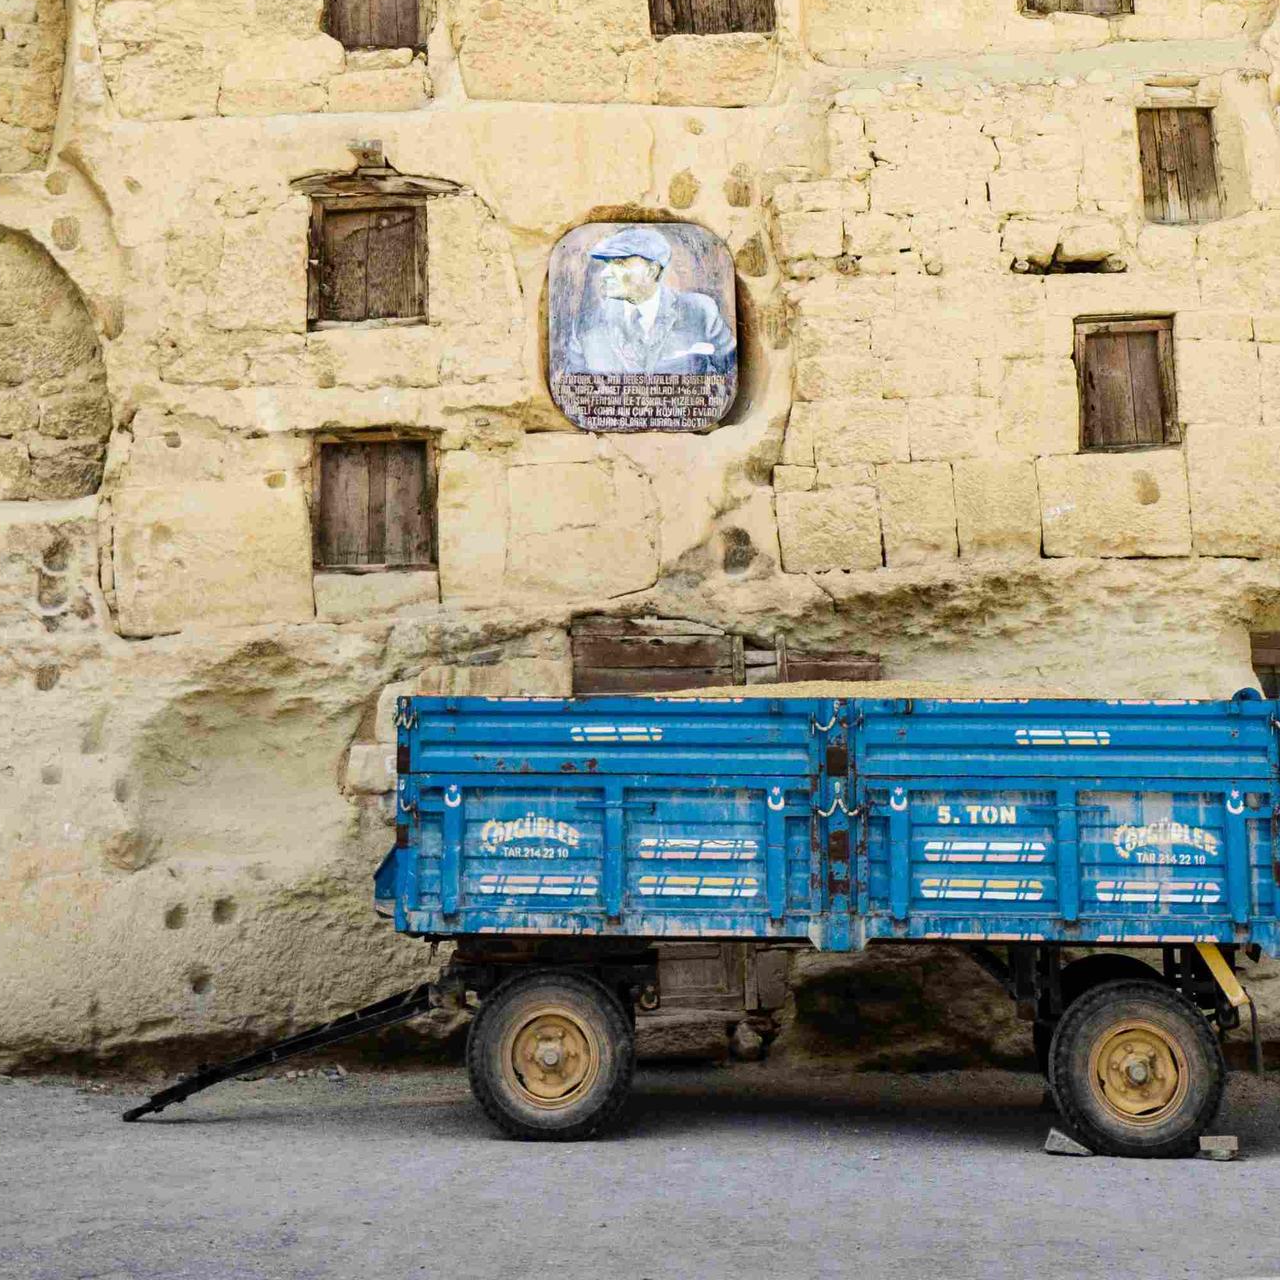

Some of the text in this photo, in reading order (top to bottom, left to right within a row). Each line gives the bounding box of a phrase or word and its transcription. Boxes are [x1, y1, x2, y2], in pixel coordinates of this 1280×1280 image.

[966, 805, 1017, 824] TON
[543, 847, 554, 859] 22
[557, 847, 569, 859] 10
[1179, 854, 1191, 866] 22
[1193, 854, 1206, 866] 10
